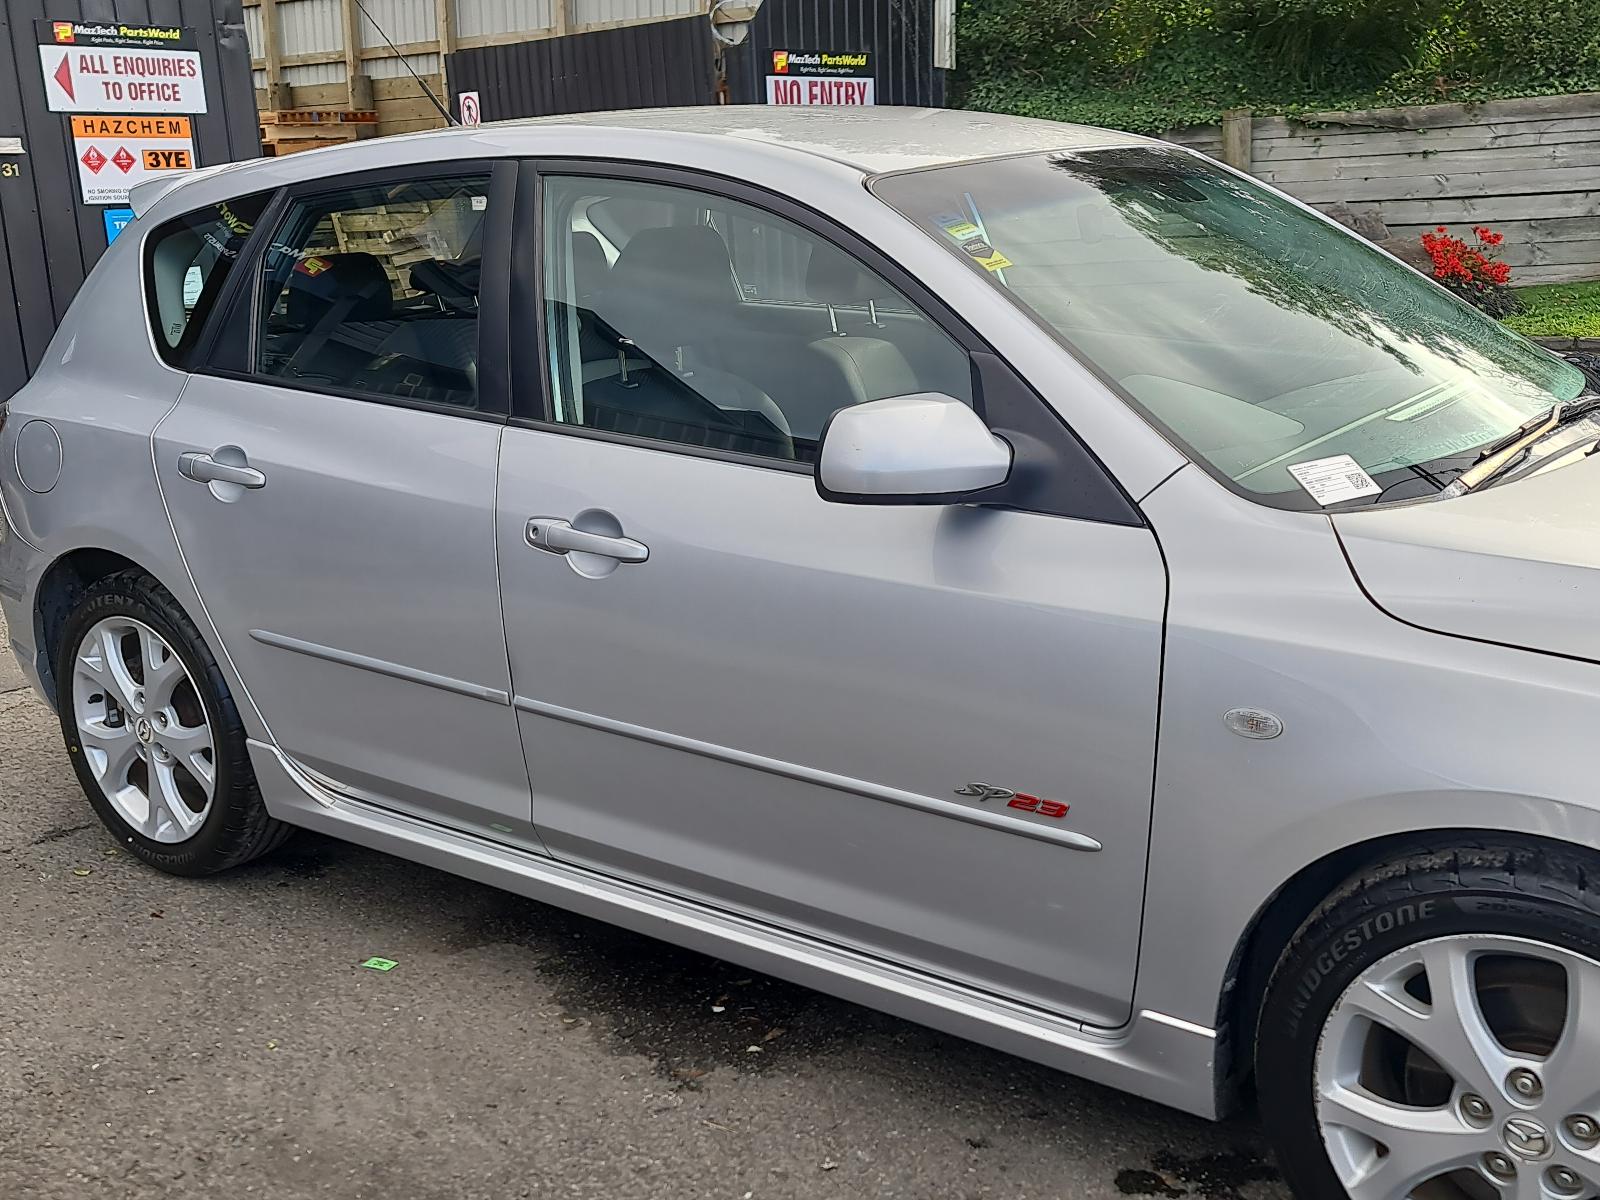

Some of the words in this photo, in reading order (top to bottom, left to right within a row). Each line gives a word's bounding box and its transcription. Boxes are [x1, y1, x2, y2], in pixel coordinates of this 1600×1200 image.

[73, 24, 118, 36] MazTech
[118, 26, 181, 40] PartsWorld
[78, 54, 109, 74] ALL
[113, 56, 196, 78] ENQUIRIES
[788, 53, 820, 64] MazTech
[821, 54, 865, 65] PartsWorld
[101, 81, 123, 100] TO
[128, 82, 181, 101] OFFICE
[773, 80, 801, 105] NO
[808, 80, 868, 105] ENTRY
[83, 119, 182, 136] HAZCHEM
[147, 151, 187, 168] 3YE
[1, 163, 20, 177] 31
[953, 781, 1071, 818] SP23
